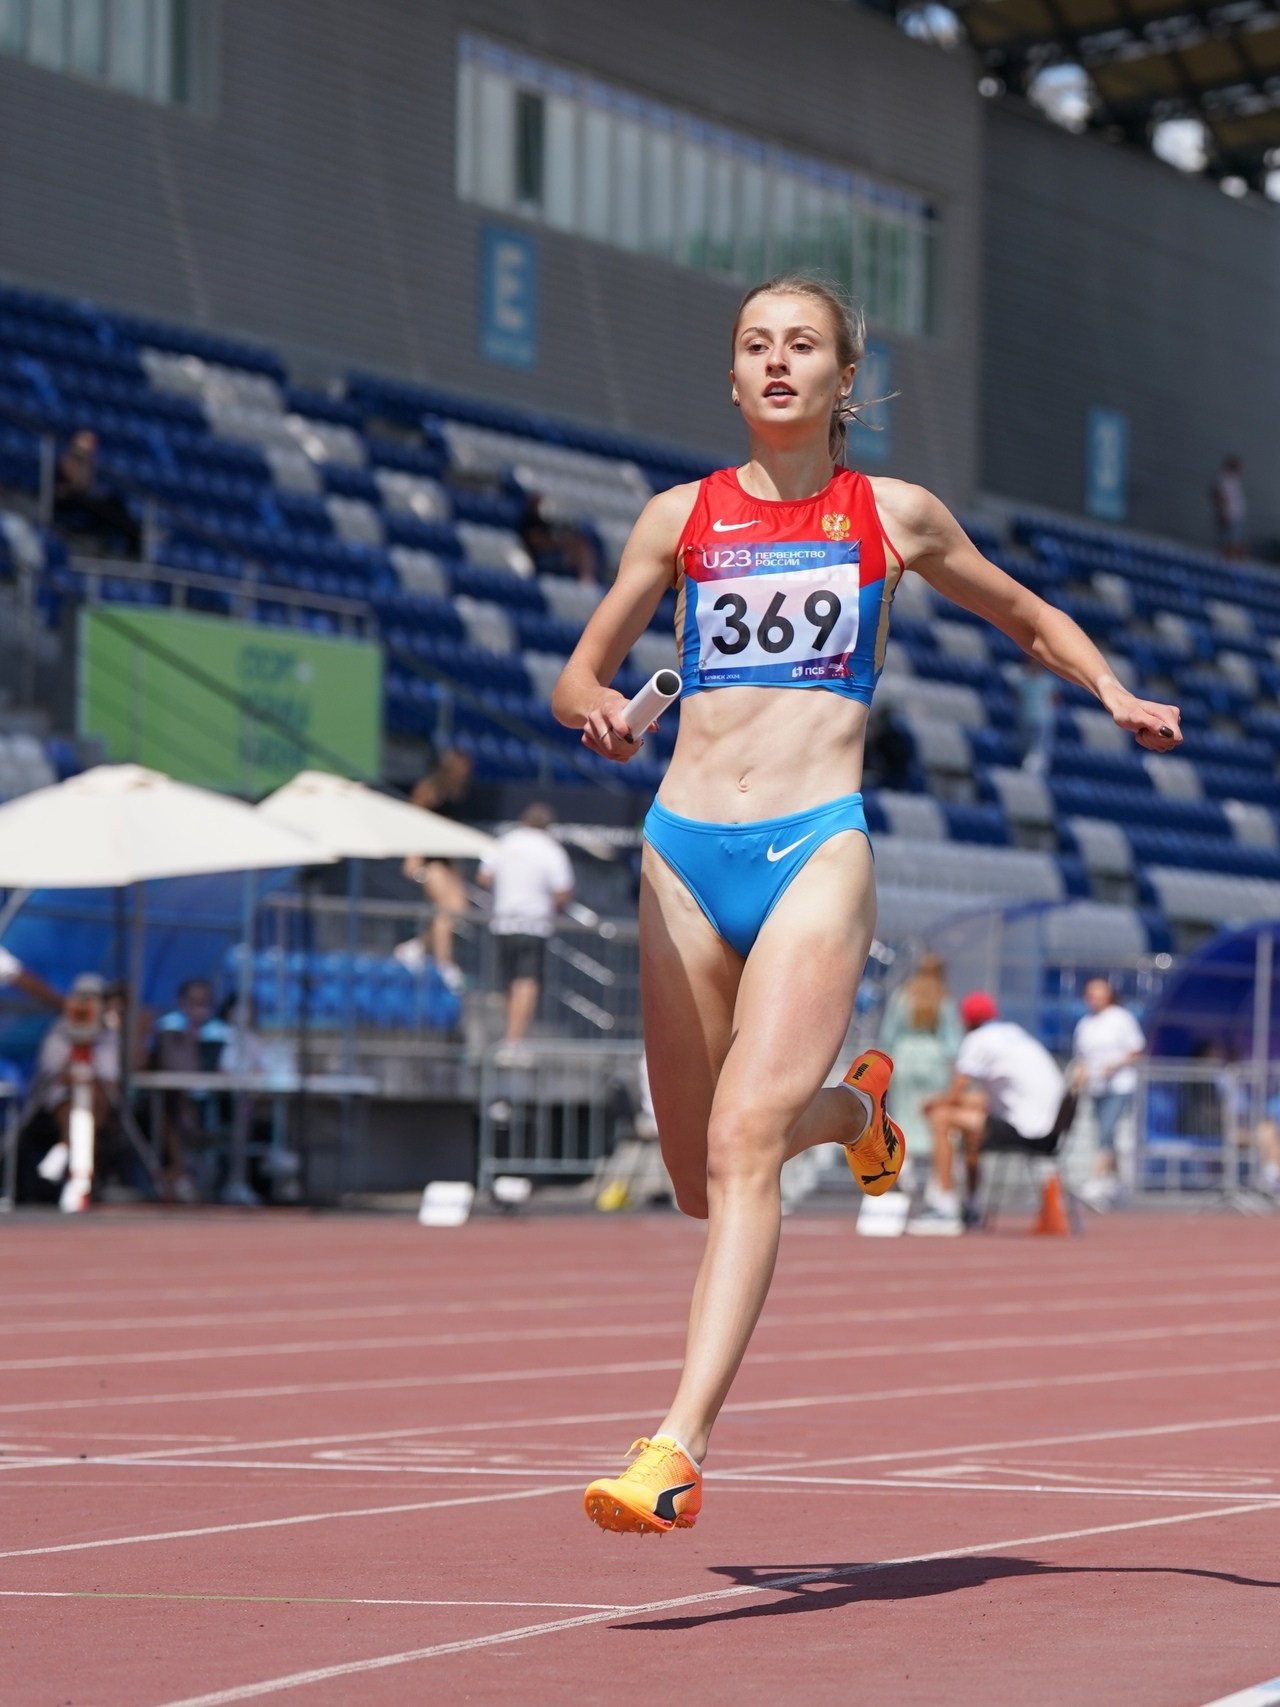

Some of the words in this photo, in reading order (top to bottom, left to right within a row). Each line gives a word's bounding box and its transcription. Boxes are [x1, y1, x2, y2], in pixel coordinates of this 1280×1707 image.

[702, 549, 751, 569] U23
[755, 550, 826, 560] ПЕРВЕНСТВО
[755, 558, 800, 567] РОССИИ
[711, 589, 842, 655] 369
[805, 666, 825, 676] ПСБ
